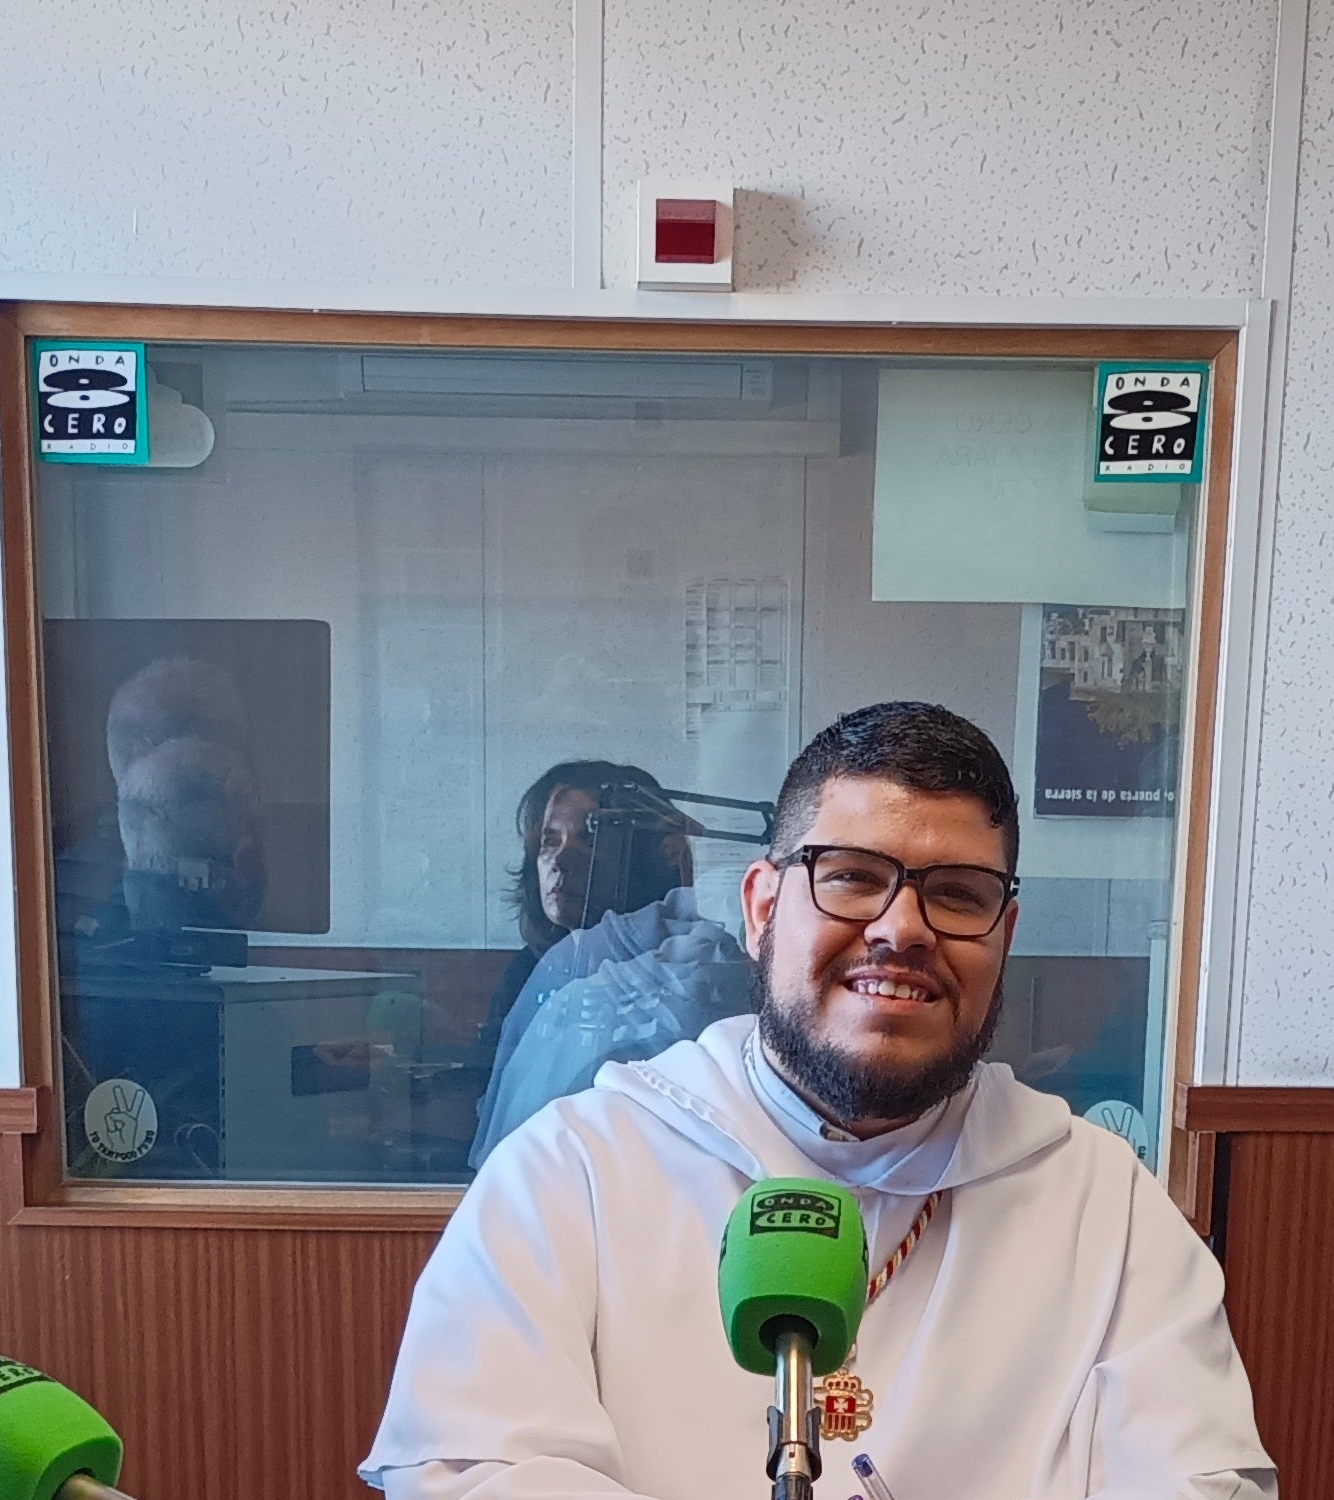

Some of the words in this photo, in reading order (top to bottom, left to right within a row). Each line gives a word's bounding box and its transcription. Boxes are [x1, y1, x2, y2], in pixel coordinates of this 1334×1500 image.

[49, 353, 126, 367] ONDA
[1115, 376, 1191, 390] ONDA
[43, 413, 127, 435] CERO
[46, 442, 129, 451] RADIO
[1104, 434, 1186, 455] CERO
[1104, 462, 1186, 472] RADIO
[1044, 788, 1083, 803] sierra
[1086, 789, 1098, 803] la
[1101, 789, 1116, 803] de
[1120, 788, 1161, 802] puerta
[764, 1197, 827, 1209] ONDA
[767, 1212, 826, 1226] CERO
